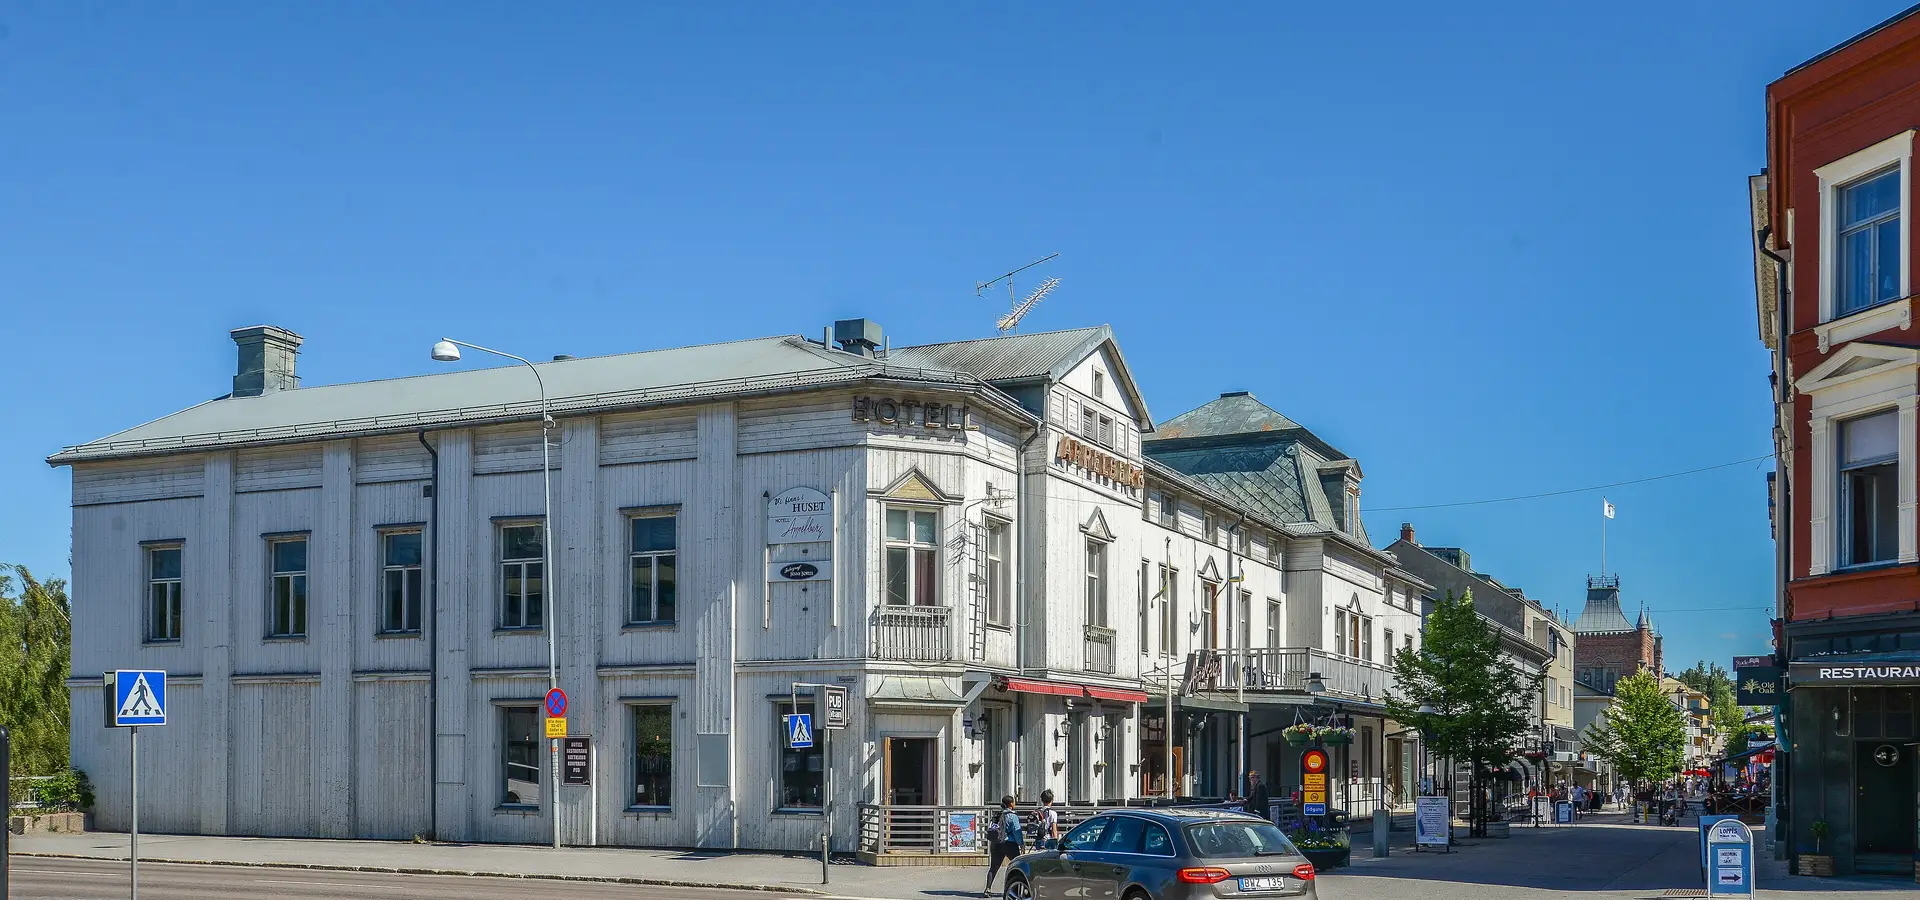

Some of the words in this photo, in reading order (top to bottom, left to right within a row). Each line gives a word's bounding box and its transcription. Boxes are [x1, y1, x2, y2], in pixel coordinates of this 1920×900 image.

[852, 395, 980, 430] HOTELL
[792, 502, 826, 513] HUSET
[829, 695, 842, 708] PUB
[1244, 878, 1261, 888] BWZ
[1267, 877, 1282, 887] 135
